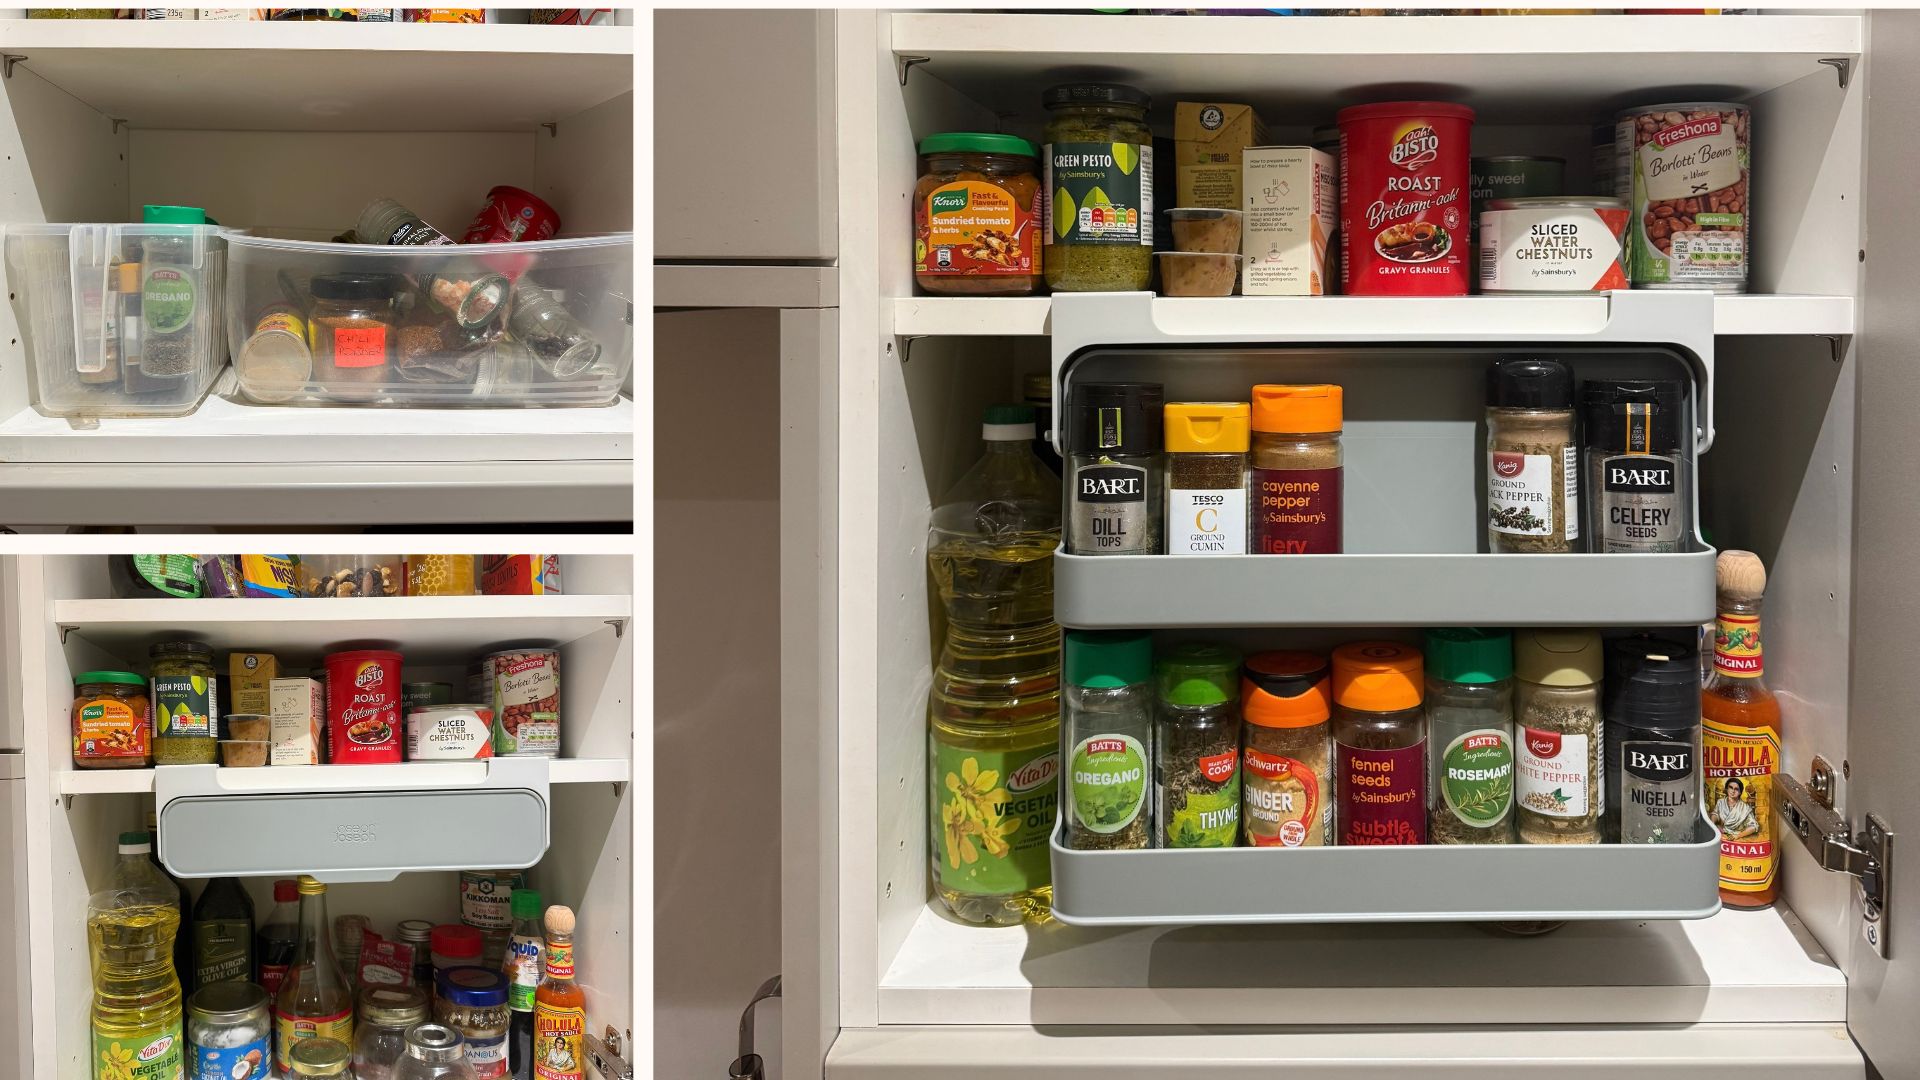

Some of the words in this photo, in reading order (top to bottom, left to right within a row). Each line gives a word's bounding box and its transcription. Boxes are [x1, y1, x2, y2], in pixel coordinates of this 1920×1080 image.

[1406, 126, 1432, 141] aah!
[1659, 121, 1717, 146] Freshona
[1392, 136, 1438, 164] BISTO
[1054, 154, 1079, 167] GREEN
[1083, 154, 1112, 167] PESTO
[1650, 152, 1696, 177] Borlotti
[1698, 144, 1732, 164] Beans
[1066, 171, 1105, 180] Sainsbury's
[1488, 172, 1525, 184] sweet
[1690, 170, 1710, 179] Water
[1388, 177, 1441, 191] ROAST
[933, 196, 966, 207] Knorr
[1366, 188, 1460, 230] Britanni-aah!
[933, 216, 974, 225] Sundried
[976, 217, 1010, 225] tomato
[1532, 224, 1578, 235] SLICED
[1531, 236, 1578, 247] WATER
[1516, 248, 1593, 260] CHESTNUTS
[1410, 266, 1450, 274] GRANULES
[1541, 268, 1576, 276] Sainsbury's
[145, 291, 190, 302] OREGANO
[1263, 482, 1320, 494] cayenne
[1492, 479, 1525, 489] GROUND
[1263, 496, 1311, 509] pepper
[1506, 491, 1544, 502] PEPPER
[1196, 509, 1217, 533] C
[1270, 512, 1326, 524] Sainsbury's
[1611, 507, 1671, 526] CELERY
[1092, 518, 1126, 535] DILL
[1626, 527, 1657, 538] SEEDS
[1096, 537, 1121, 547] TOPS
[1190, 543, 1224, 551] CUMIN
[1262, 535, 1308, 554] fiery
[509, 659, 543, 674] Freshona
[356, 670, 384, 686] BISTO
[157, 684, 172, 692] GREEN
[173, 683, 191, 691] PESTO
[354, 694, 385, 703] ROAST
[429, 733, 474, 741] CHESTNUTS
[1468, 737, 1498, 748] BATTS
[1091, 741, 1122, 752] BATTS
[1246, 752, 1288, 771] Schwartz
[1524, 756, 1562, 769] GROUND
[1703, 746, 1771, 767] HOLULA
[1351, 757, 1394, 771] fennel
[1012, 766, 1040, 787] Vita
[1076, 768, 1140, 785] OREGANO
[1449, 762, 1512, 781] ROSEMARY
[1543, 772, 1581, 782] PEPPER
[1710, 769, 1732, 777] HOT
[1735, 767, 1766, 776] SAUCE
[1351, 774, 1391, 787] seeds
[1246, 784, 1293, 811] GINGER
[1352, 793, 1360, 803] by
[1360, 789, 1416, 803] Sainsbury's
[1632, 788, 1687, 806] NIGELLA
[994, 792, 1058, 816] VEGETA
[1200, 803, 1238, 830] THYME
[1253, 808, 1279, 821] GROUND
[1647, 807, 1674, 817] SEEDS
[1028, 814, 1051, 828] OIL
[1283, 824, 1303, 832] GROUND
[1353, 820, 1409, 836] subtle
[1283, 834, 1302, 842] WHOLE
[1721, 843, 1765, 855] GINAL
[1754, 865, 1762, 873] ml
[466, 892, 510, 904] KIKKOMAN
[472, 912, 482, 920] Soy
[198, 965, 219, 977] EXTRA
[220, 956, 247, 969] VIRGIN
[202, 972, 226, 983] OLIVE
[227, 966, 240, 976] OIL
[537, 1012, 581, 1030] CHOLULA
[131, 1053, 178, 1076] VEGETABLE
